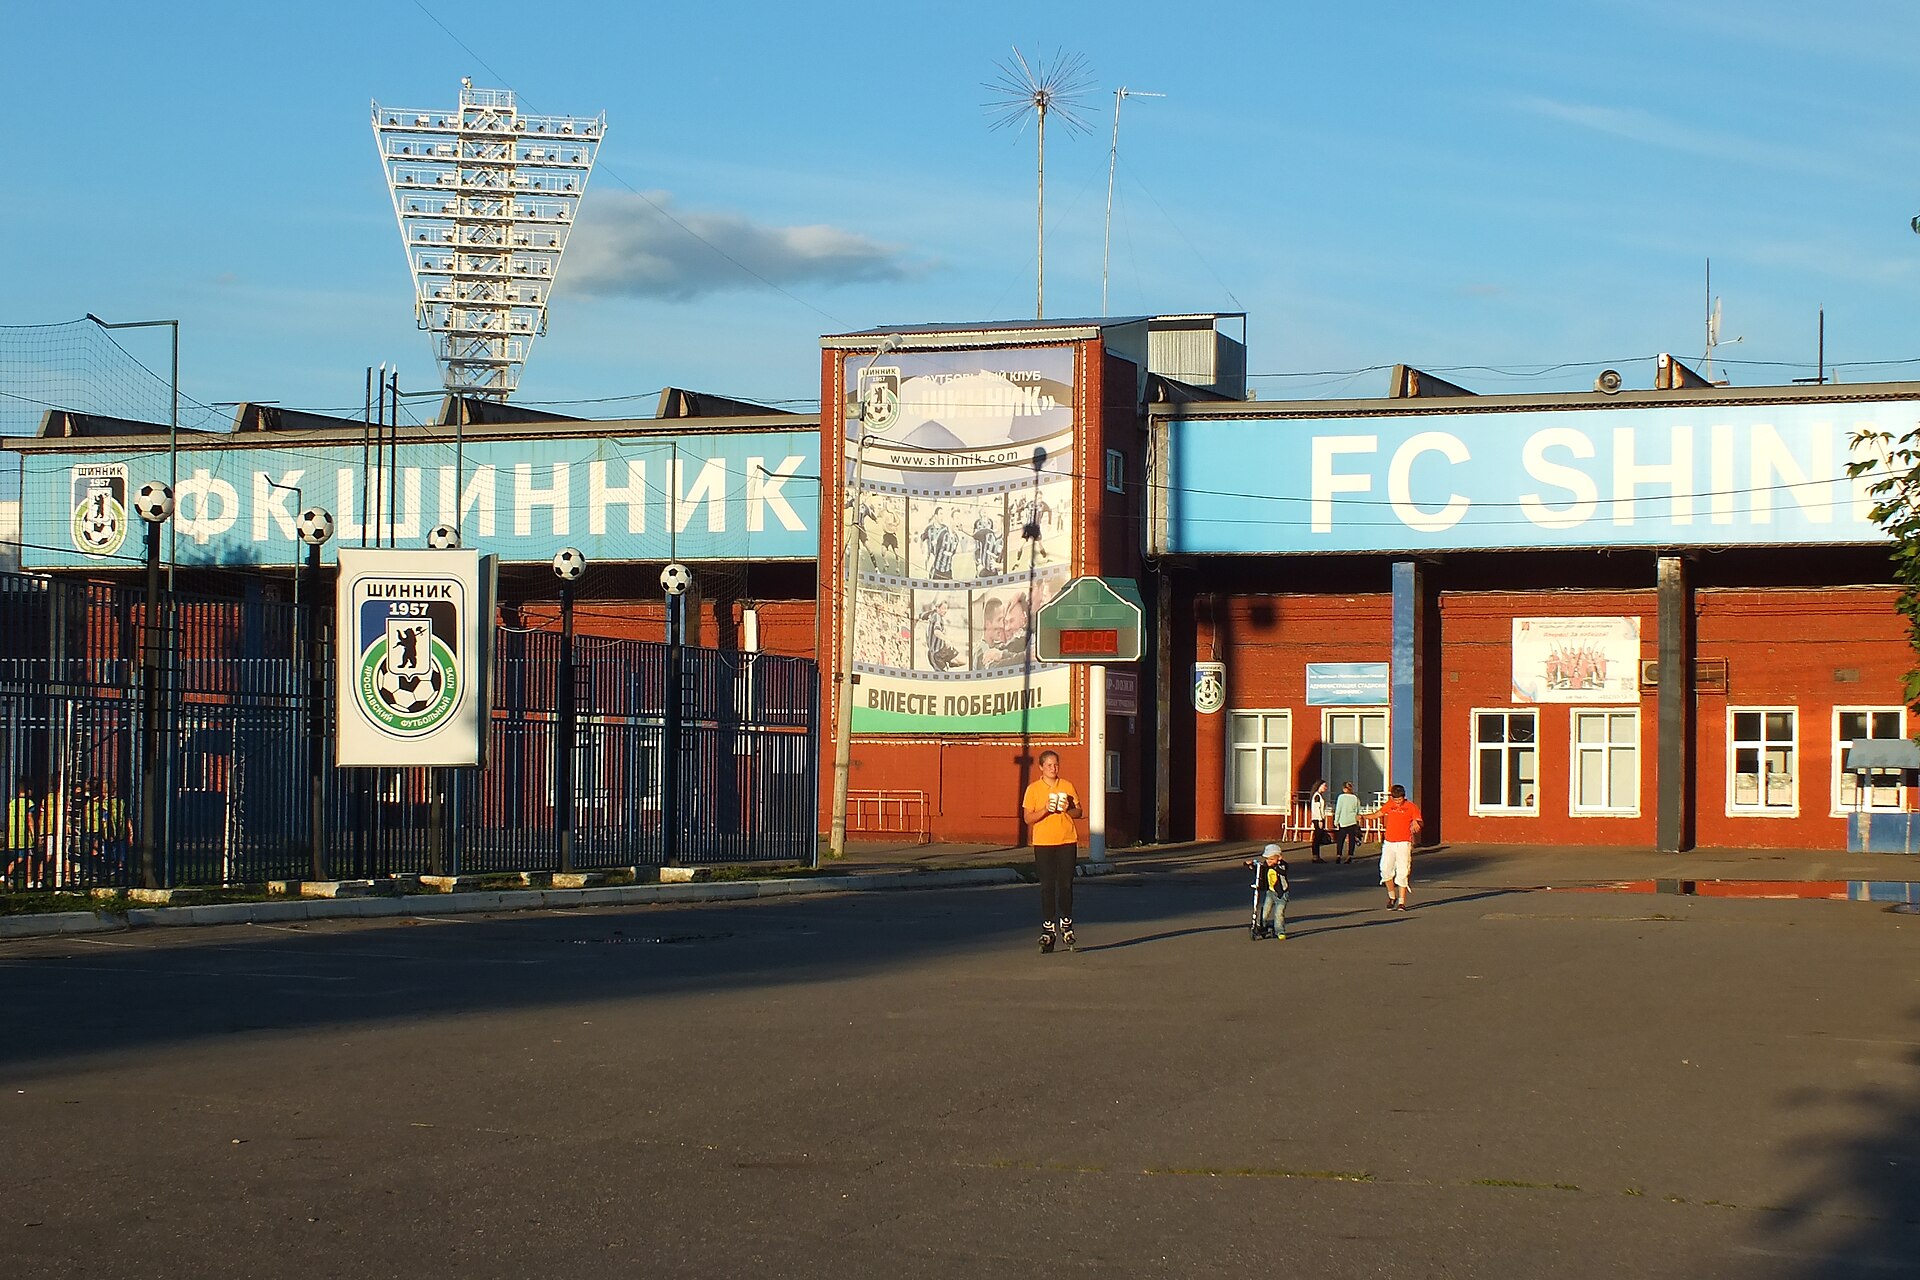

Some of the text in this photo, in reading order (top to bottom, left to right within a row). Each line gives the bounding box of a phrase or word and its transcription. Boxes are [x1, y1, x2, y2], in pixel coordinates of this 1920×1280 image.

[1009, 369, 1042, 382] КЛУБ
[890, 450, 1018, 466] www.shinnik.com
[78, 467, 123, 476] ШИННИК
[89, 479, 111, 487] 1957
[1311, 431, 1472, 534] FC
[172, 467, 305, 545] ФК
[336, 455, 809, 541] ШИННИК
[367, 584, 452, 598] ШИННИК
[389, 602, 429, 616] 1957
[362, 665, 455, 728] ЯРОСЛАВСКИЙ ФУТБОЛЬНЫЙ КЛУБ
[868, 686, 1042, 716] ВМЕСТЕ ПОБЕДИМ!
